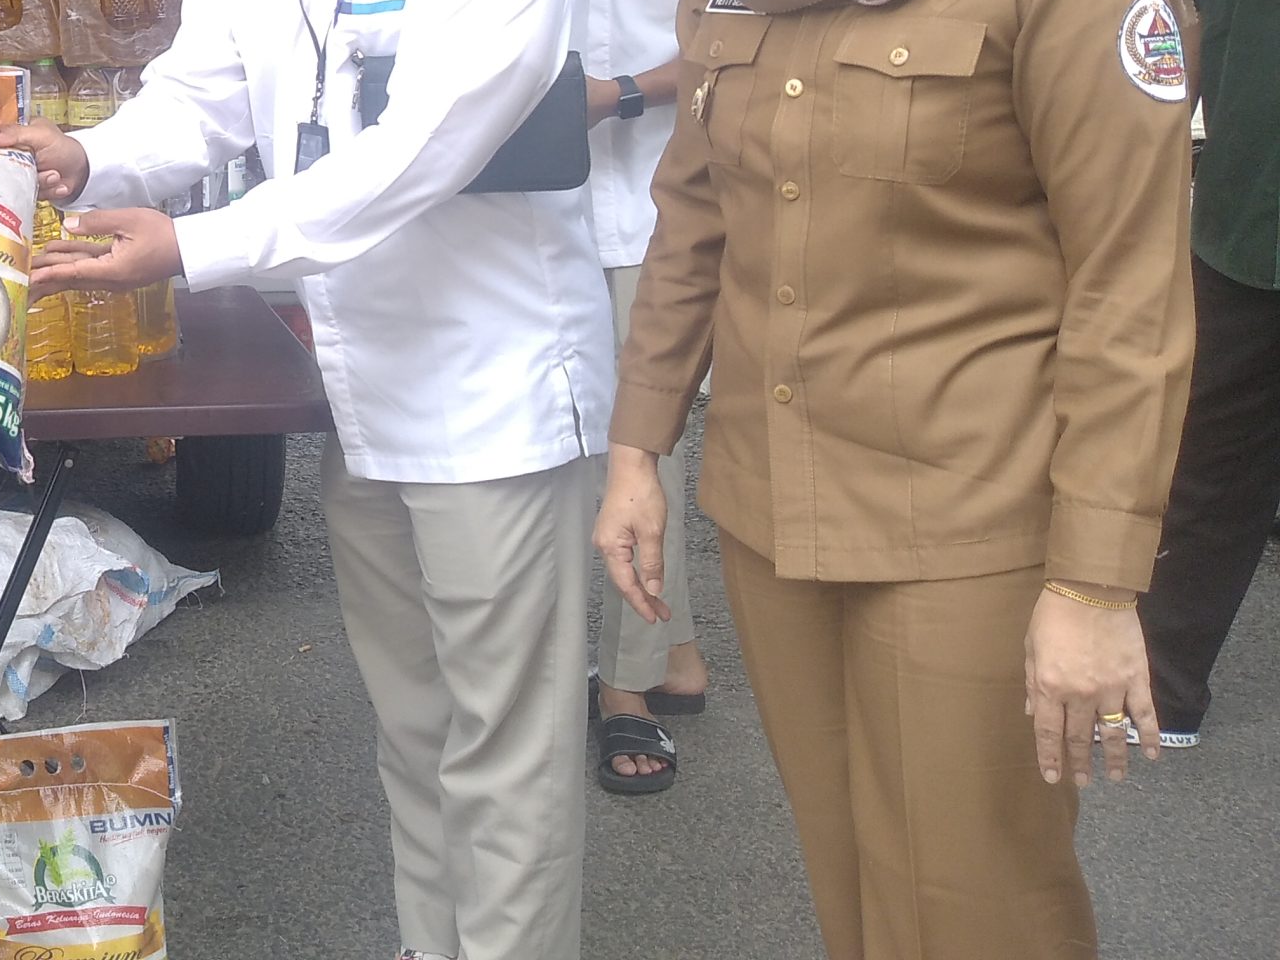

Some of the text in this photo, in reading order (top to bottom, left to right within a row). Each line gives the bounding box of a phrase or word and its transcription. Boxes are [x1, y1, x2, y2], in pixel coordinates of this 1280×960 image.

[89, 812, 172, 834] BUMN
[14, 919, 41, 930] Beras
[93, 909, 140, 920] Indonesia
